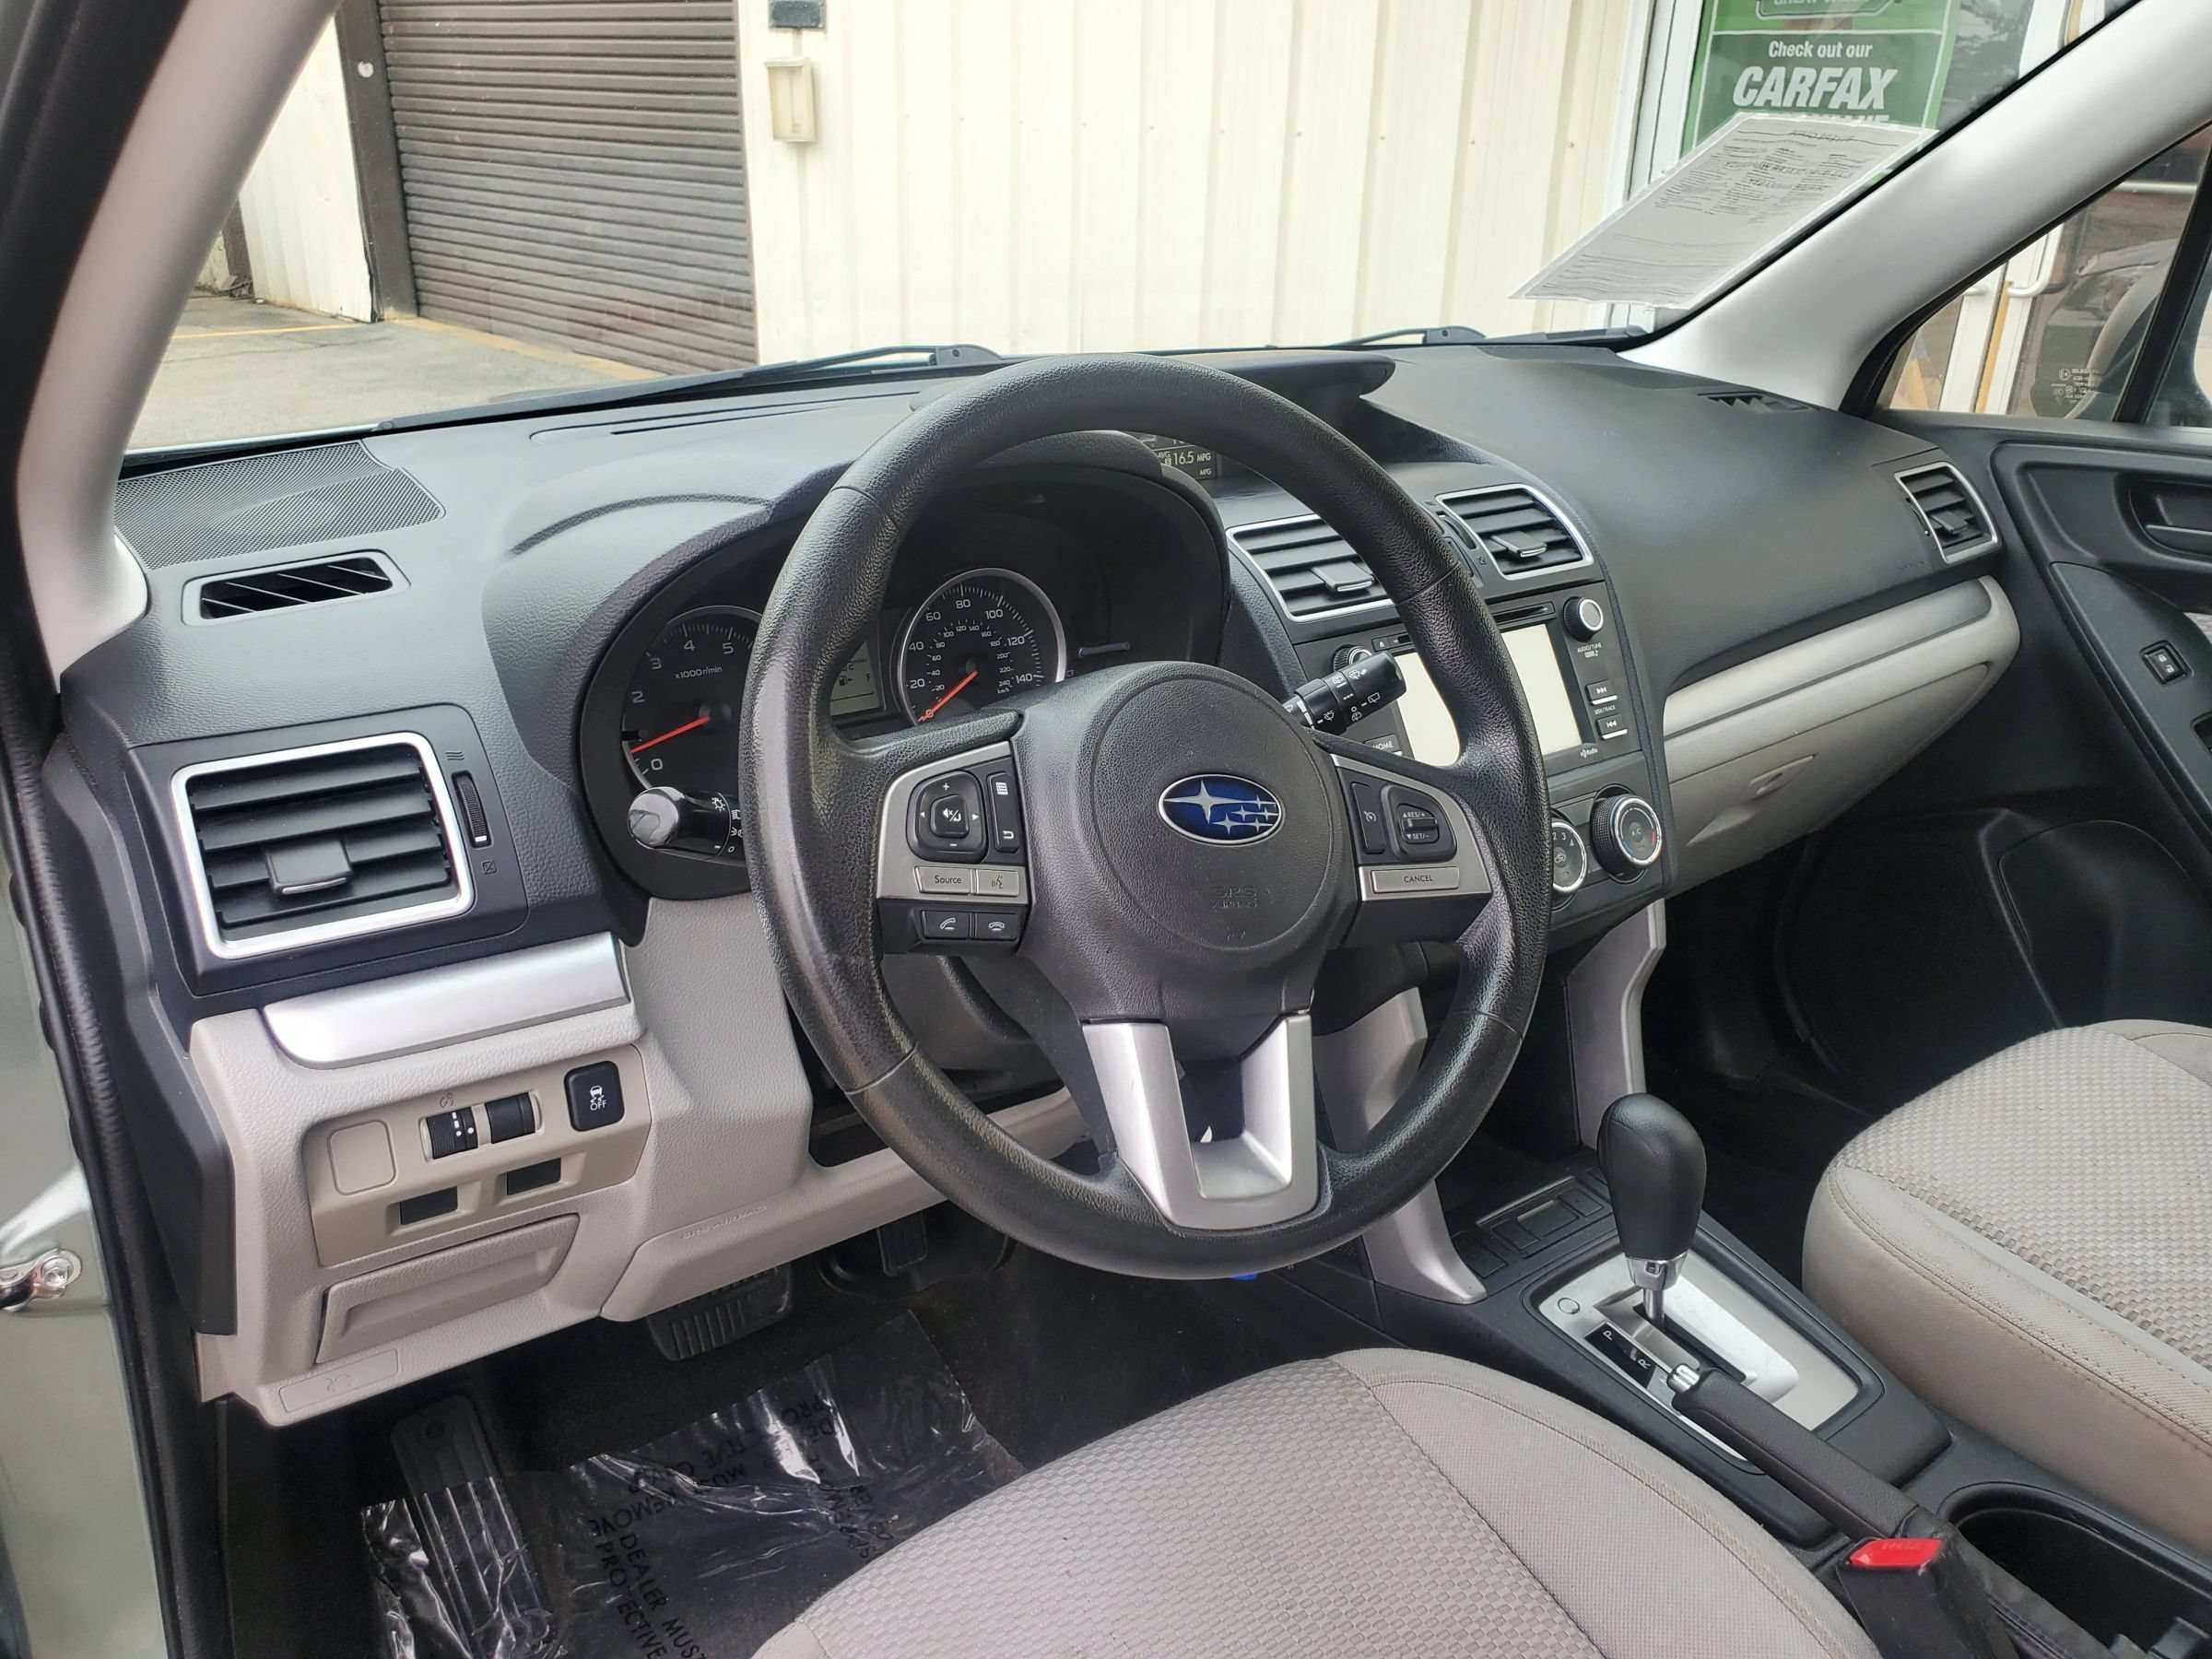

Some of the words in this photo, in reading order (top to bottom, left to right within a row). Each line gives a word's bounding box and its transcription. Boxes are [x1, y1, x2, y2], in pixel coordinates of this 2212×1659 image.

[1769, 41, 1814, 58] Check
[1818, 43, 1842, 58] out
[1846, 44, 1873, 58] our
[1733, 65, 1899, 111] CARFAX
[1173, 451, 1194, 465] 16.5
[1196, 453, 1211, 462] MPG
[956, 599, 971, 609] 80
[925, 611, 941, 621] 60
[985, 609, 1004, 619] 100
[683, 640, 696, 652] 4
[909, 641, 924, 652] 40
[1007, 636, 1025, 647] 120
[723, 642, 735, 654] 5
[649, 657, 662, 670] 3
[910, 678, 925, 688] 20
[1016, 673, 1033, 684] 140
[631, 690, 645, 703] 2
[651, 759, 664, 771] 0
[935, 875, 962, 884] Source
[1404, 875, 1433, 883] CANCEL
[590, 1100, 606, 1111] OFF
[1603, 1330, 1613, 1341] P
[1637, 1359, 1652, 1370] R
